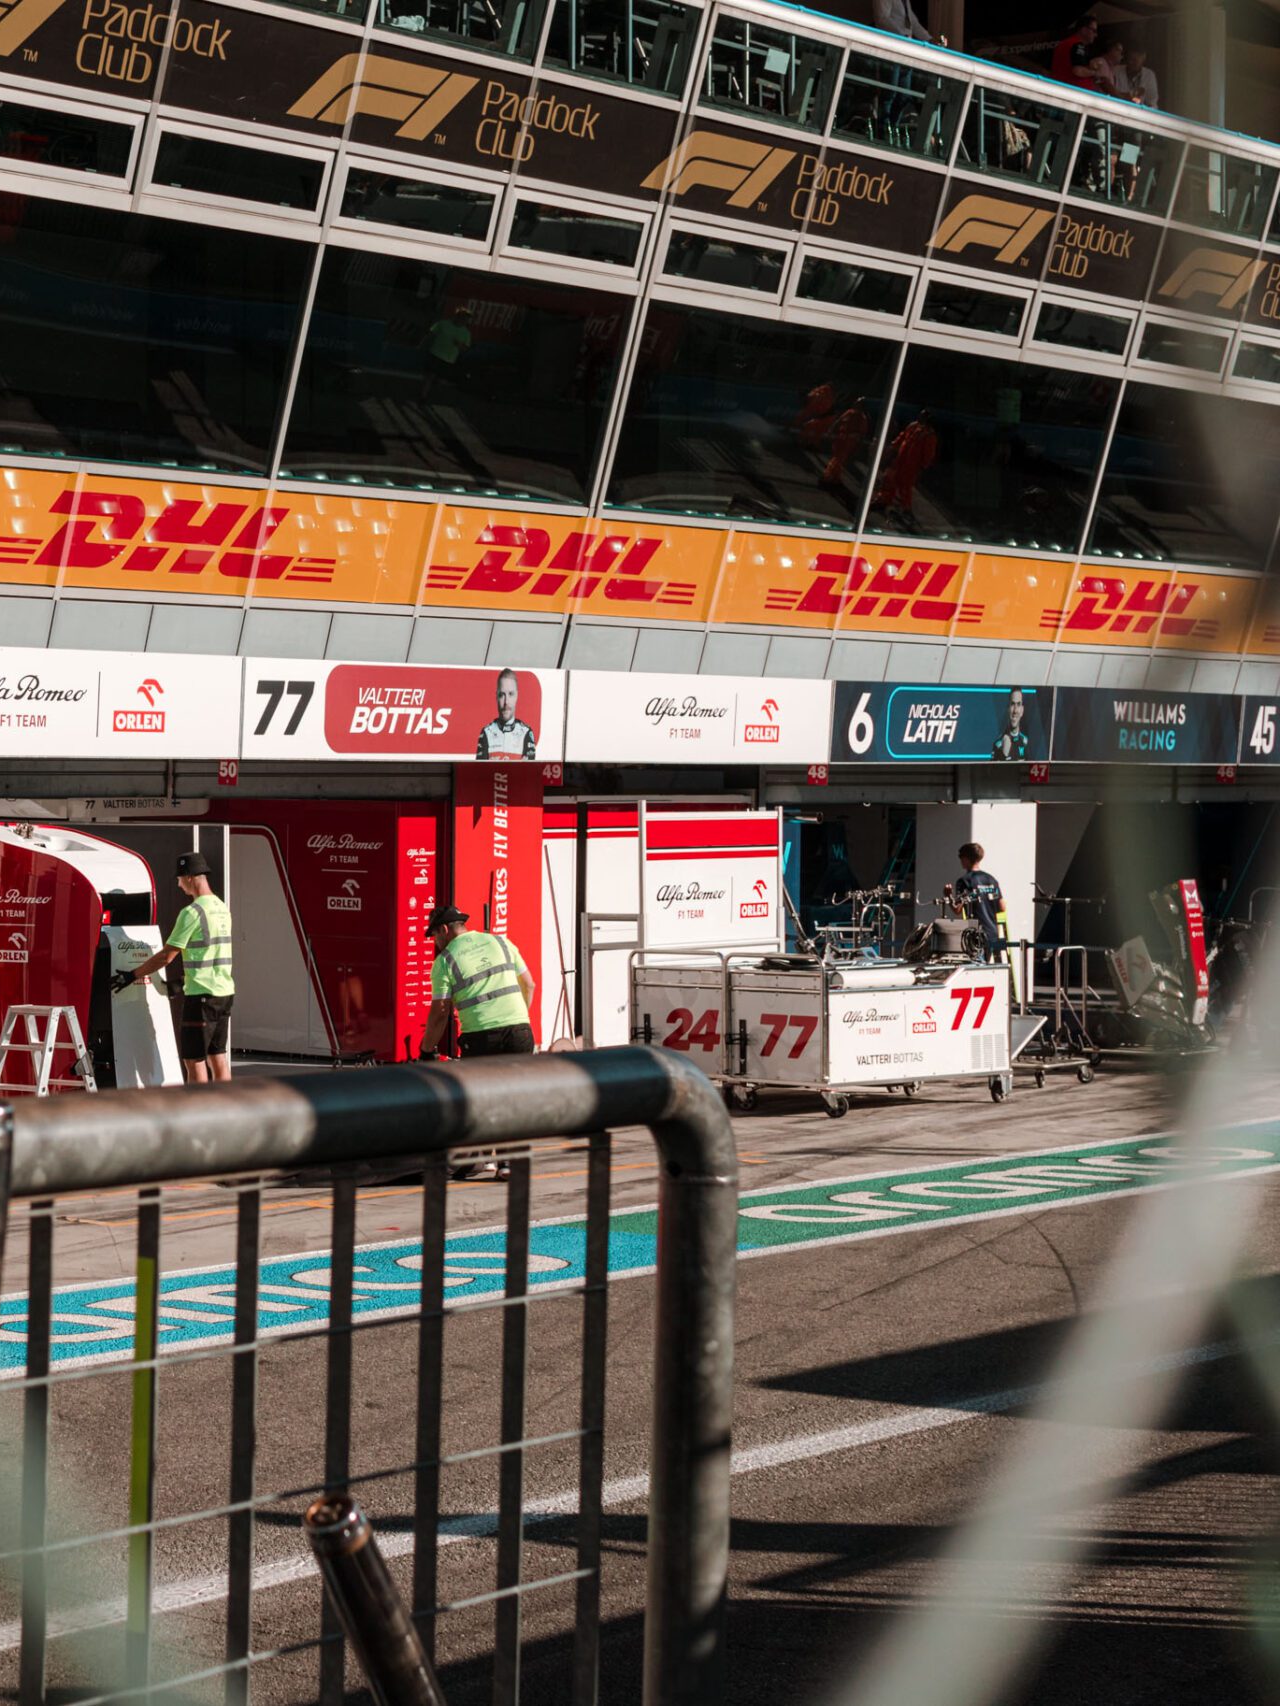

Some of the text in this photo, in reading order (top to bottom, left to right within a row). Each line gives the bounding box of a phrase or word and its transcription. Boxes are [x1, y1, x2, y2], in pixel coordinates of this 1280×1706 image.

[81, 0, 231, 60] Paddock
[76, 33, 153, 84] Club
[481, 81, 600, 141] Paddock
[475, 118, 535, 162] Club
[796, 155, 893, 205] Paddock
[1055, 215, 1134, 259] Paddock
[1048, 245, 1088, 279] Club
[34, 490, 290, 580] DHL
[460, 525, 663, 602] DHL
[795, 553, 960, 621] DHL
[1062, 576, 1200, 636] DHL
[14, 674, 87, 702] Romeo
[358, 687, 425, 705] VALTTERI
[0, 714, 47, 728] F1 TEAM
[115, 712, 162, 730] ORLEN
[254, 680, 315, 736] 77
[349, 707, 451, 735] BOTTAS
[645, 696, 728, 725] Alfa Romeo
[909, 704, 960, 720] NICHOLAS
[1113, 700, 1186, 726] WILLIAMS
[670, 728, 701, 739] F1 TEAM
[746, 726, 778, 742] ORLEN
[848, 692, 874, 754] 6
[903, 720, 958, 743] LATIFI
[1249, 705, 1277, 755] 45
[1119, 728, 1176, 751] RACING
[219, 761, 238, 778] 50
[542, 764, 561, 779] 49
[808, 765, 827, 778] 48
[1030, 764, 1048, 777] 47
[103, 799, 136, 809] VALTTERI
[137, 799, 164, 809] BOTTAS
[494, 772, 508, 828] BETTER
[307, 833, 383, 854] Alfa Romeo
[494, 832, 508, 859] FLY
[330, 855, 359, 864] F1 TEAM
[4, 889, 52, 904] Romeo
[329, 898, 359, 909] ORLEN
[493, 868, 508, 940] irates
[656, 882, 726, 909] Alfa Romeo
[6, 909, 26, 918] TEAM
[678, 909, 705, 920] F1 TEAM
[741, 904, 768, 917] ORLEN
[842, 1008, 900, 1028] Alfa Romeo
[950, 986, 994, 1031] 77
[662, 1007, 720, 1052] 24
[759, 1013, 818, 1059] 77
[913, 1023, 936, 1033] ORLEN
[856, 1052, 923, 1066] VALTTERI BOTTAS
